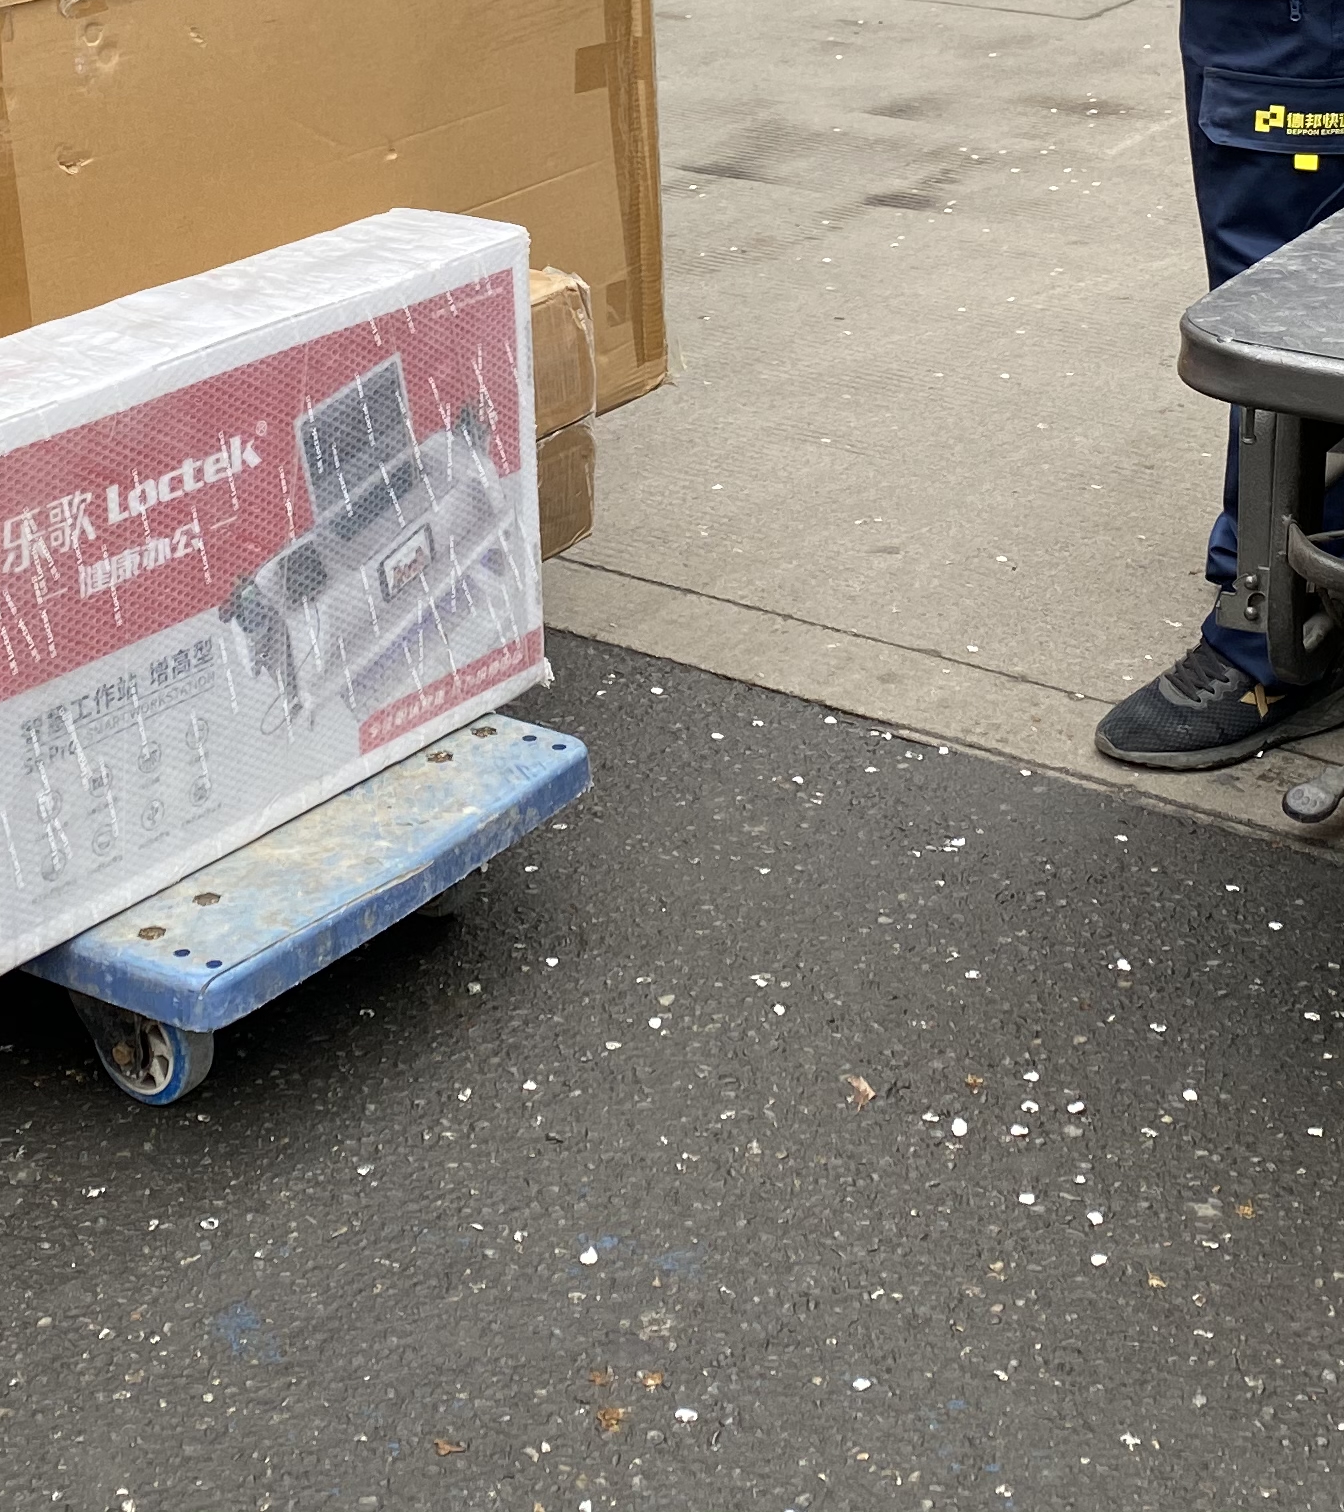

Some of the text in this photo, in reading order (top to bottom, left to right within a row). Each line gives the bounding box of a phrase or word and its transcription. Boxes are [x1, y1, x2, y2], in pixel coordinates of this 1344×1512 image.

[1, 435, 263, 575] 乐歌 Loctek
[79, 521, 205, 599] 健康办公
